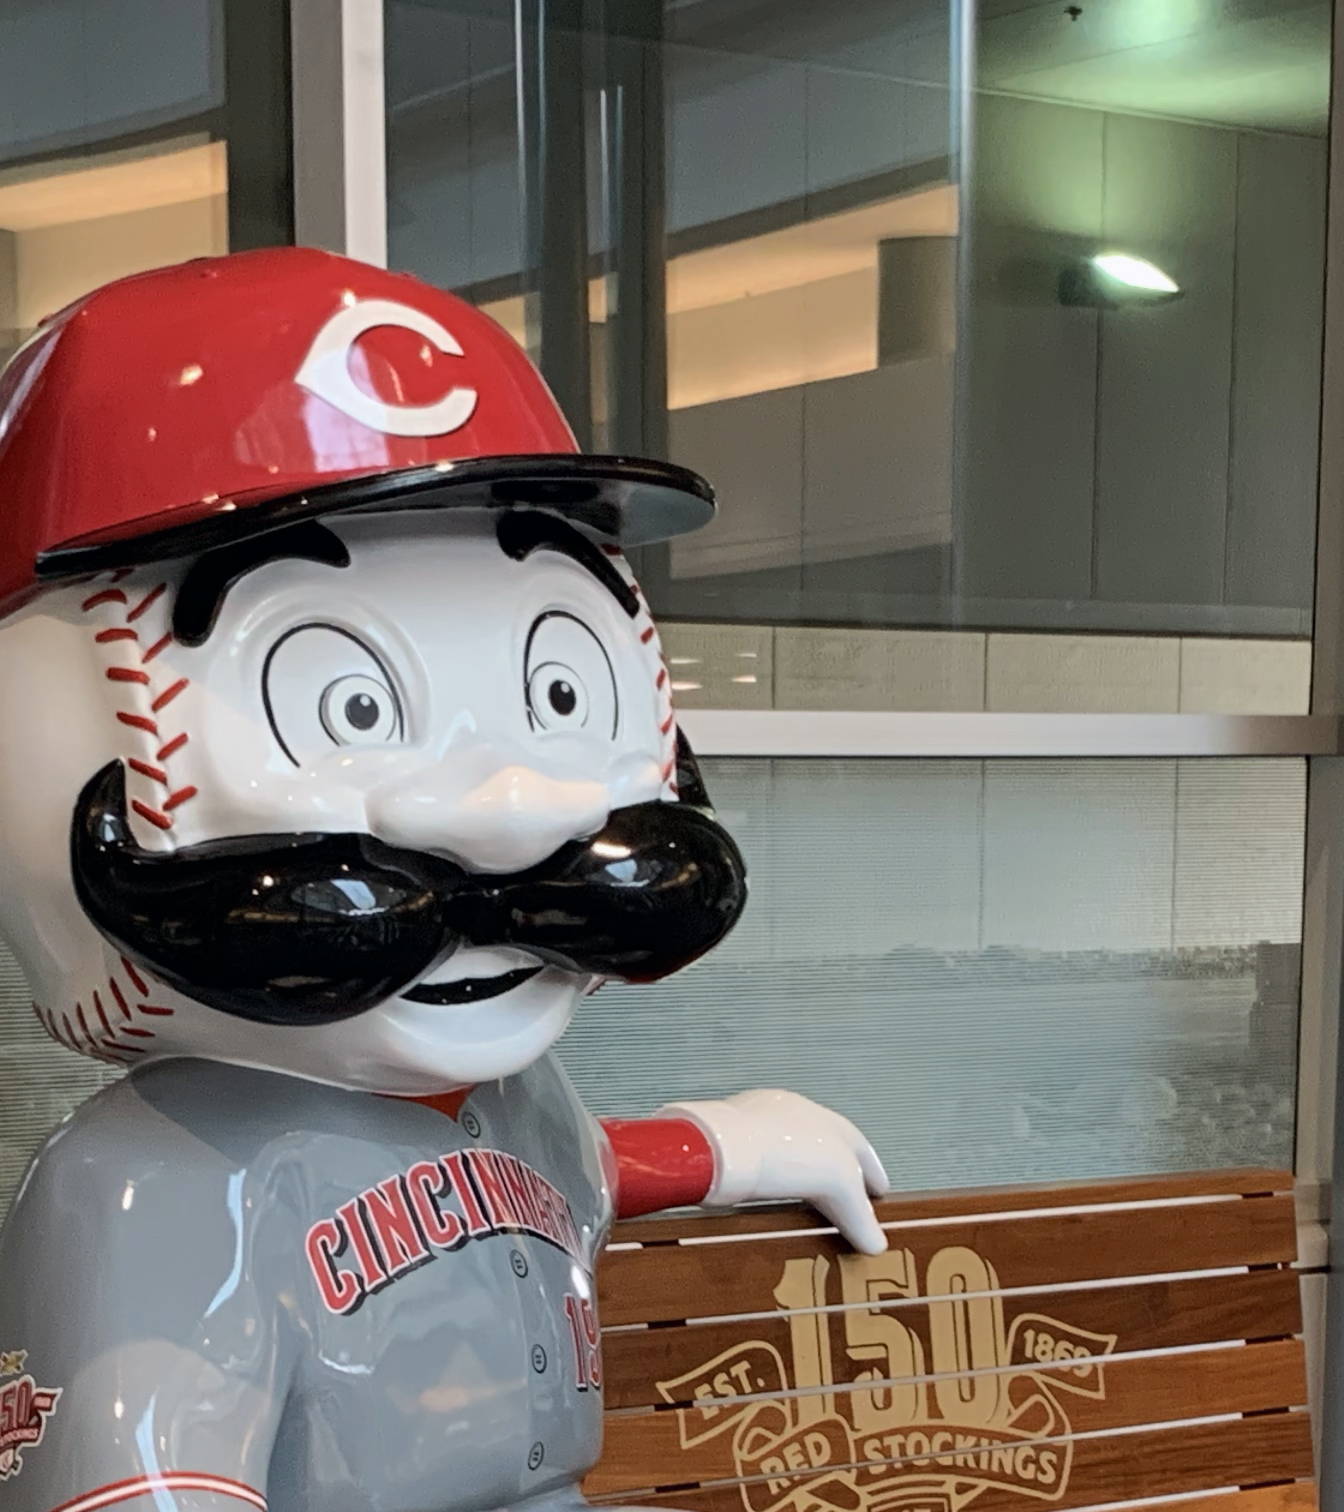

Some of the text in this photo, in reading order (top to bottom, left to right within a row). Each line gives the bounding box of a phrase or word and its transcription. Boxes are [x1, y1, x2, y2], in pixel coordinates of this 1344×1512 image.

[294, 299, 478, 438] C
[773, 1246, 1008, 1430] 150
[1022, 1328, 1093, 1378] 1869
[694, 1360, 765, 1420] EST.
[760, 1431, 1057, 1495] RED STOCKINGS
